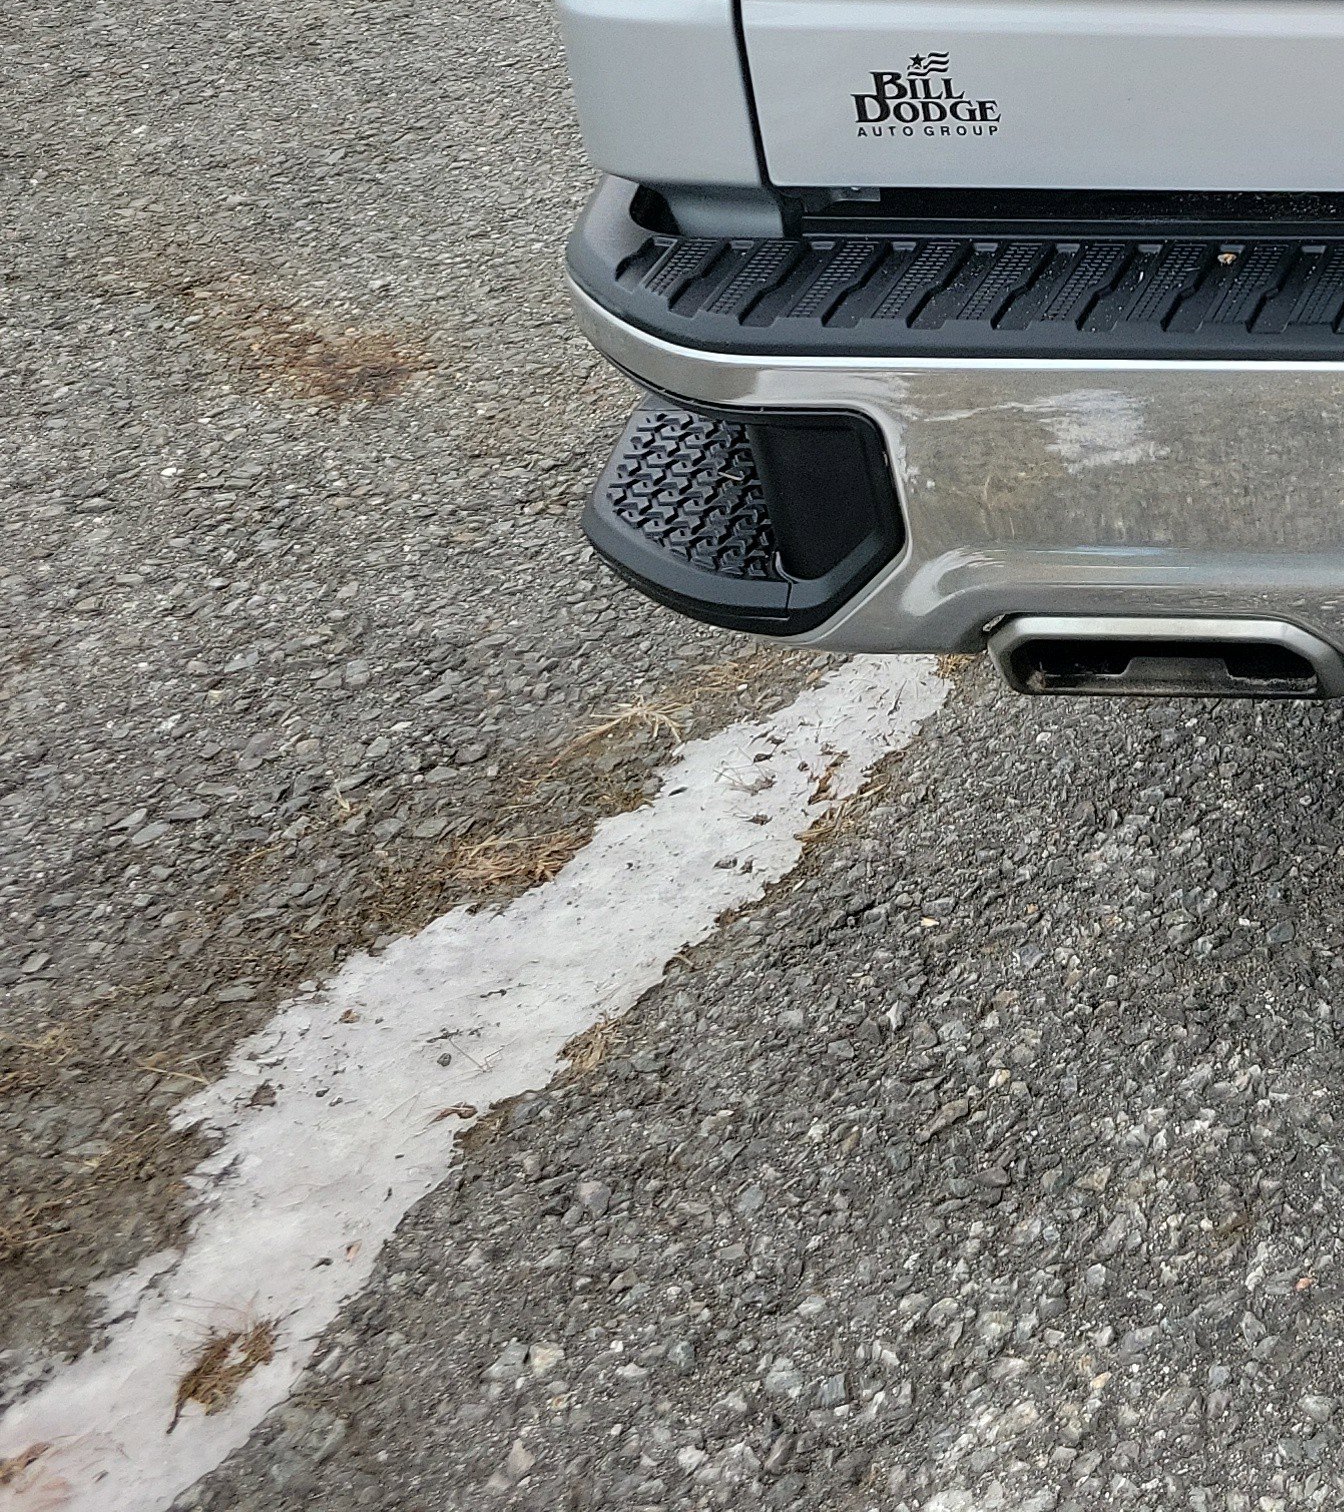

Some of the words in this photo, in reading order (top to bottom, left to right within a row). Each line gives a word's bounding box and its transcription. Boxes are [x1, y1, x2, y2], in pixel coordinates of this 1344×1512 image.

[870, 71, 965, 100] BILL
[850, 93, 1001, 123] DODGE
[857, 126, 914, 137] AUTO
[924, 125, 998, 137] GROUP
